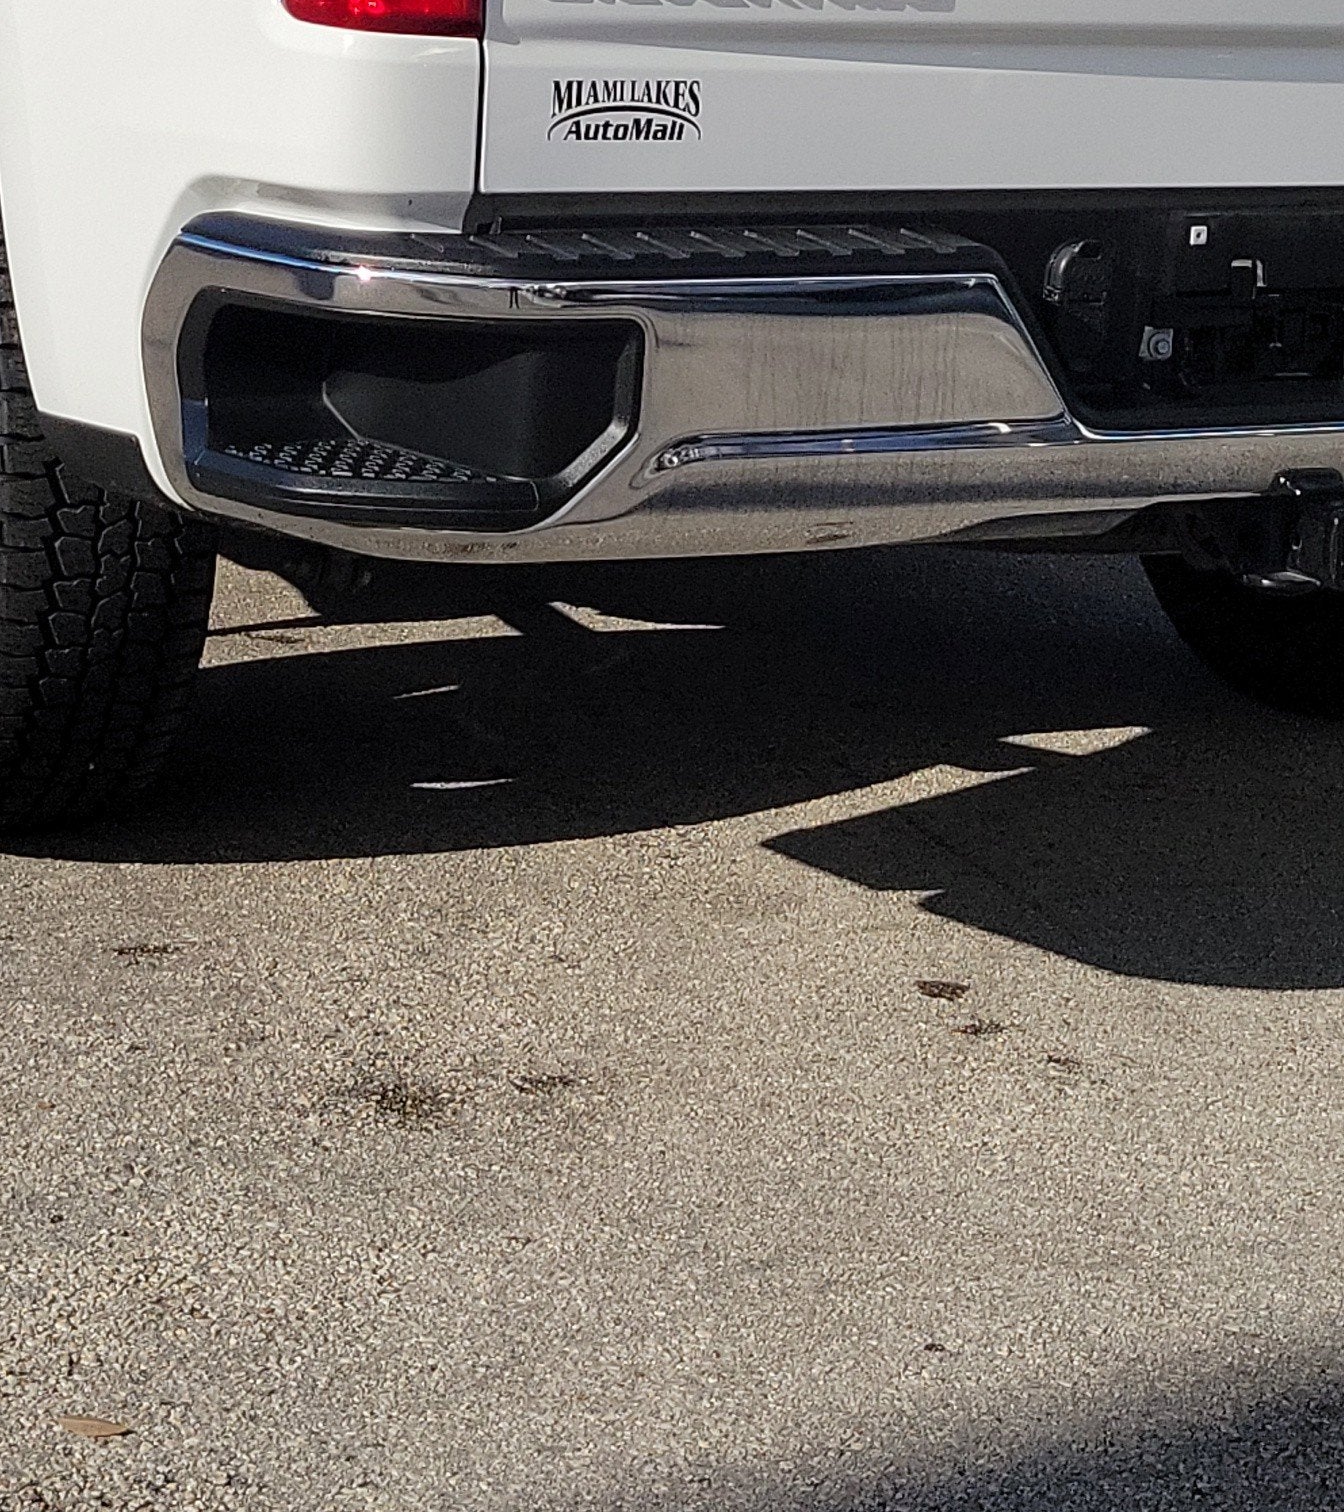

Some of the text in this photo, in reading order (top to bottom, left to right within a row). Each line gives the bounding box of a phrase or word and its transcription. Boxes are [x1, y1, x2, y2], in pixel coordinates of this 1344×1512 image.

[551, 79, 702, 121] MIAMI LAKES
[563, 117, 686, 142] AutoMall
